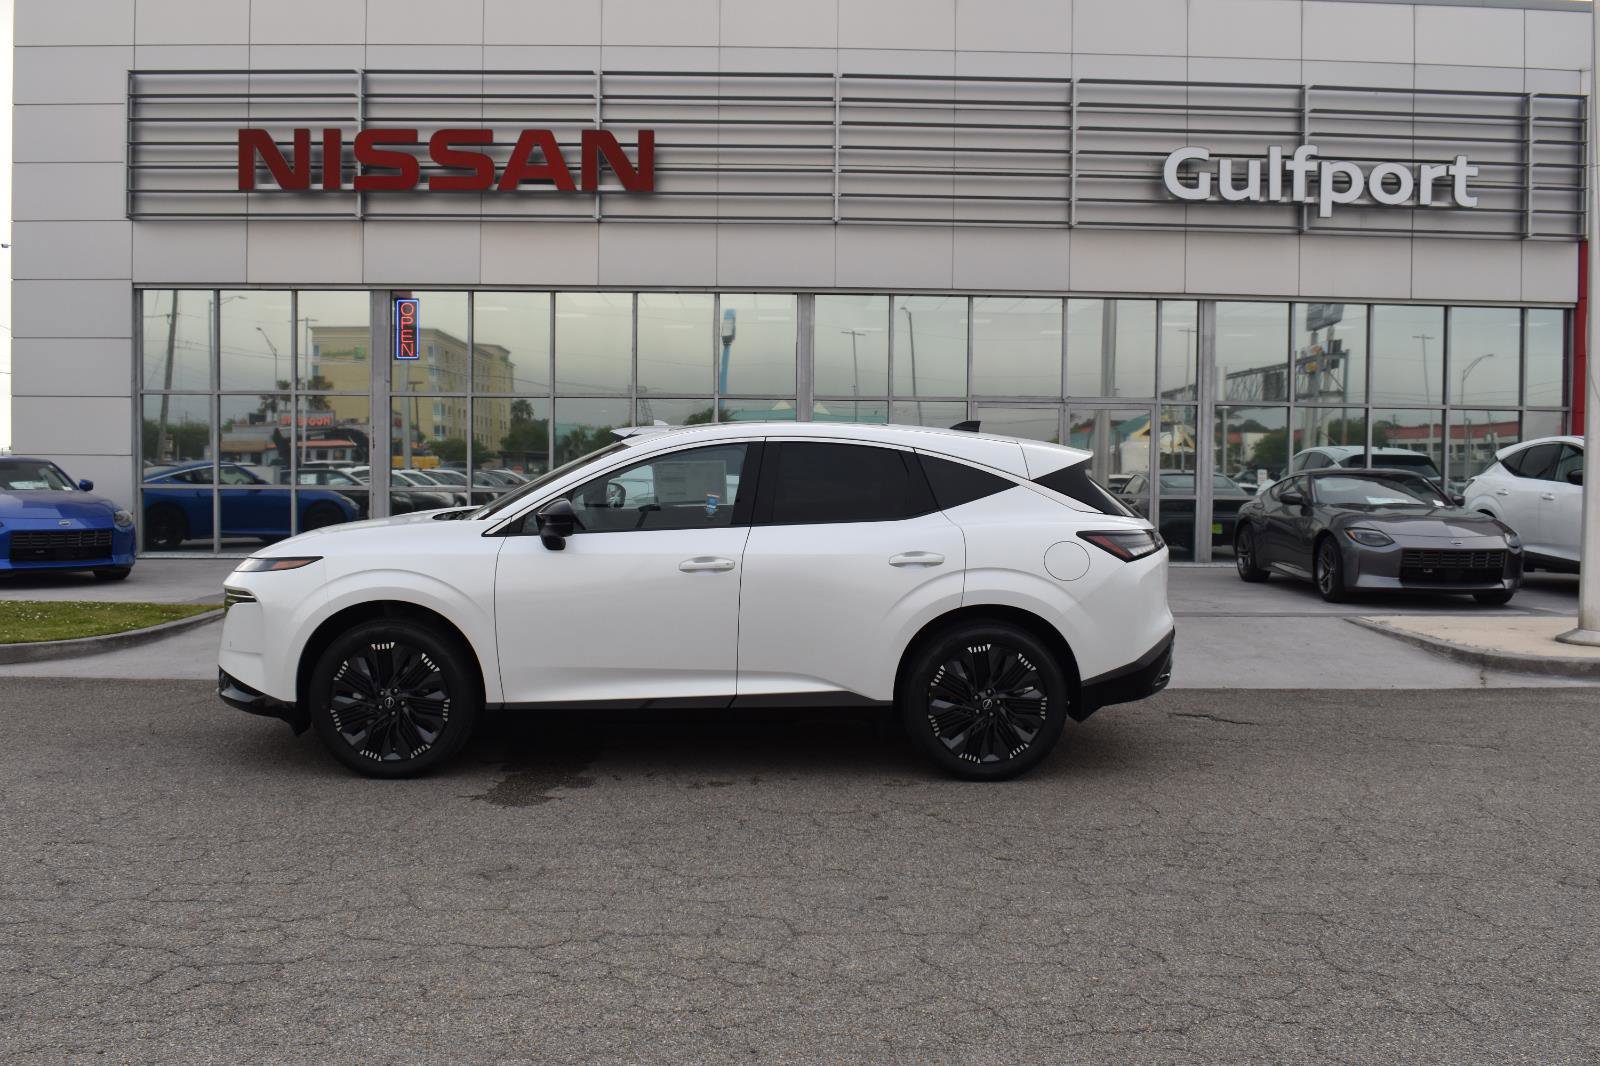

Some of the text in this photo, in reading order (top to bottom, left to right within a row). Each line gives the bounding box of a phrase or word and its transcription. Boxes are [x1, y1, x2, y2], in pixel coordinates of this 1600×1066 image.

[238, 129, 655, 192] NISSAN
[1163, 145, 1479, 218] Gulfport
[400, 302, 415, 357] OPEN
